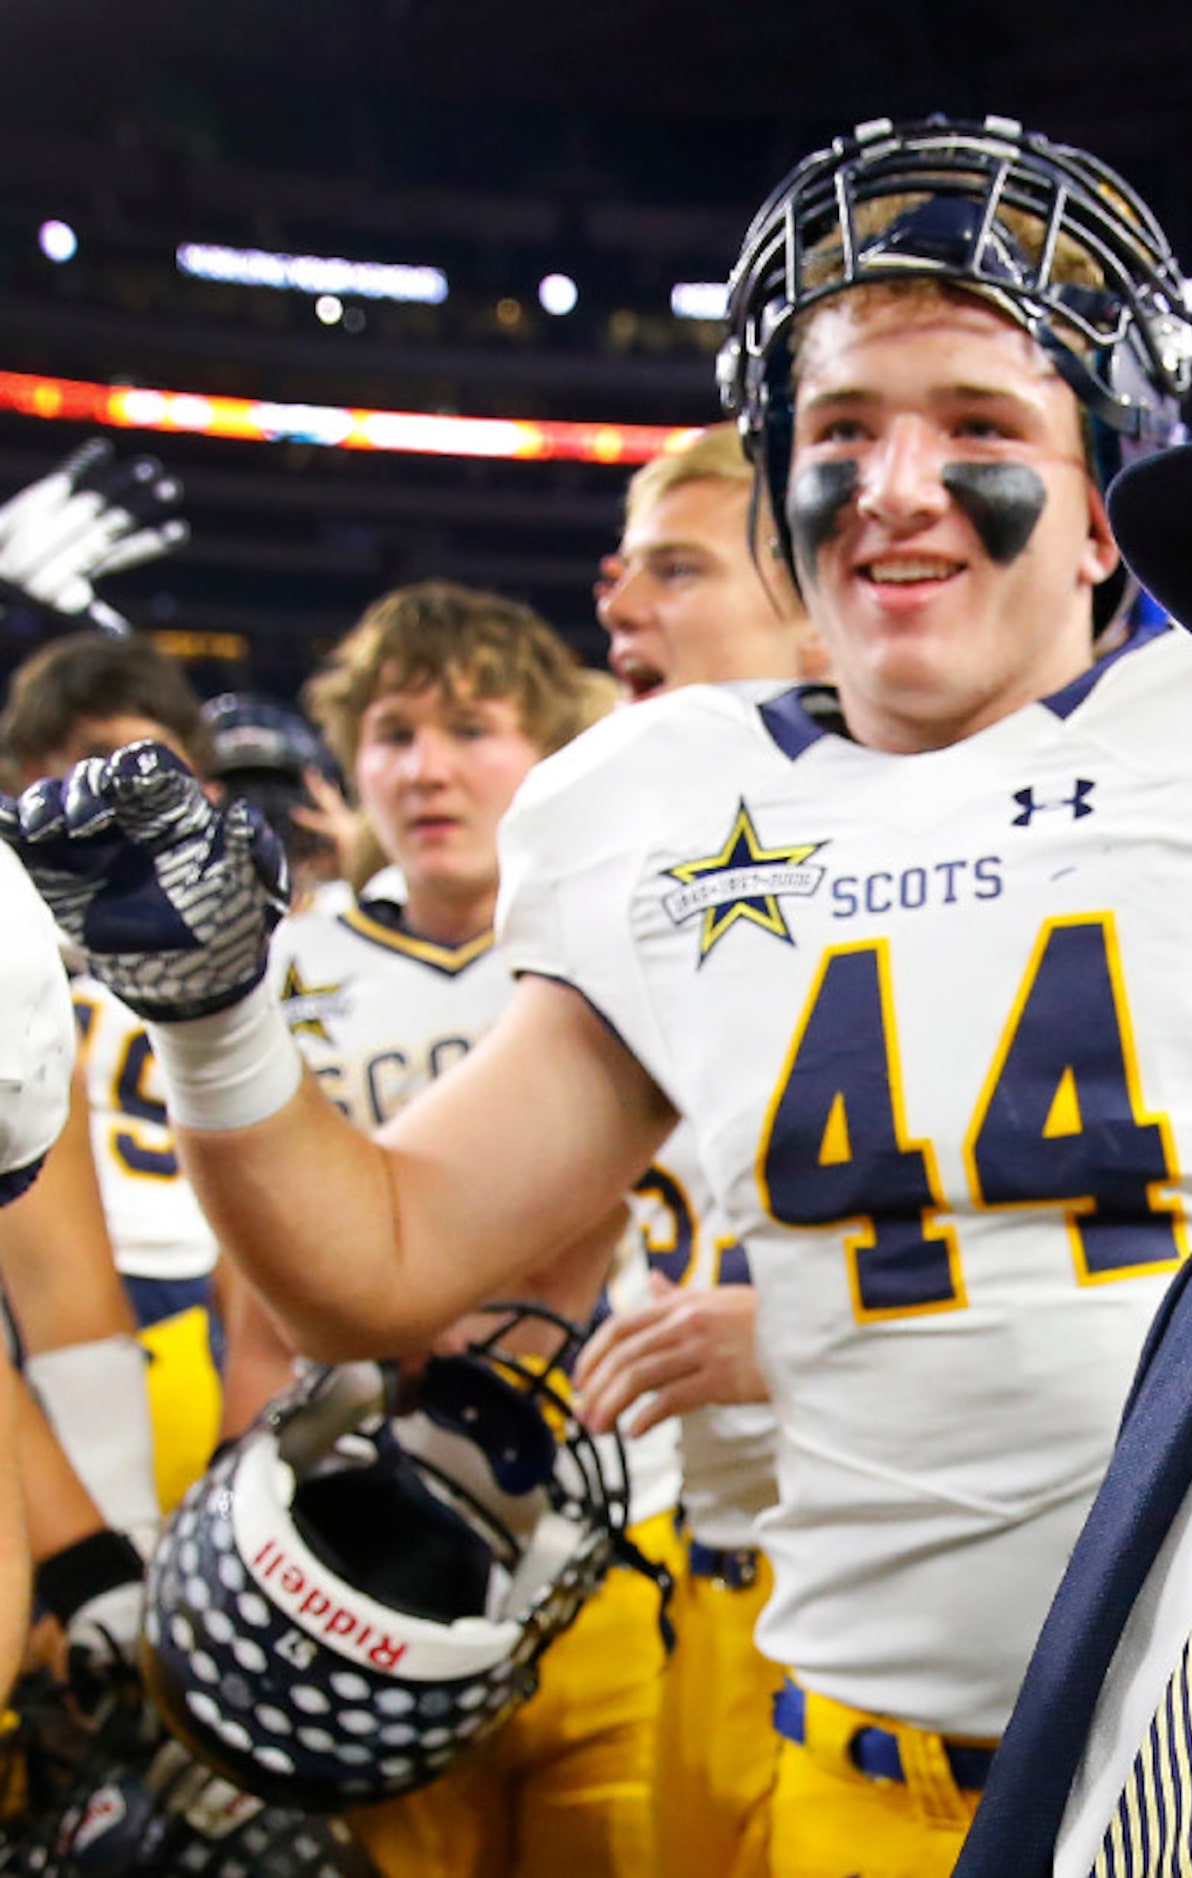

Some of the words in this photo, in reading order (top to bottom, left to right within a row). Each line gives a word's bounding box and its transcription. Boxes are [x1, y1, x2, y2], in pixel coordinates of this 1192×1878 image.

[832, 856, 1003, 918] SCOTS
[755, 909, 1190, 1325] 44
[254, 1539, 409, 1673] Riddell
